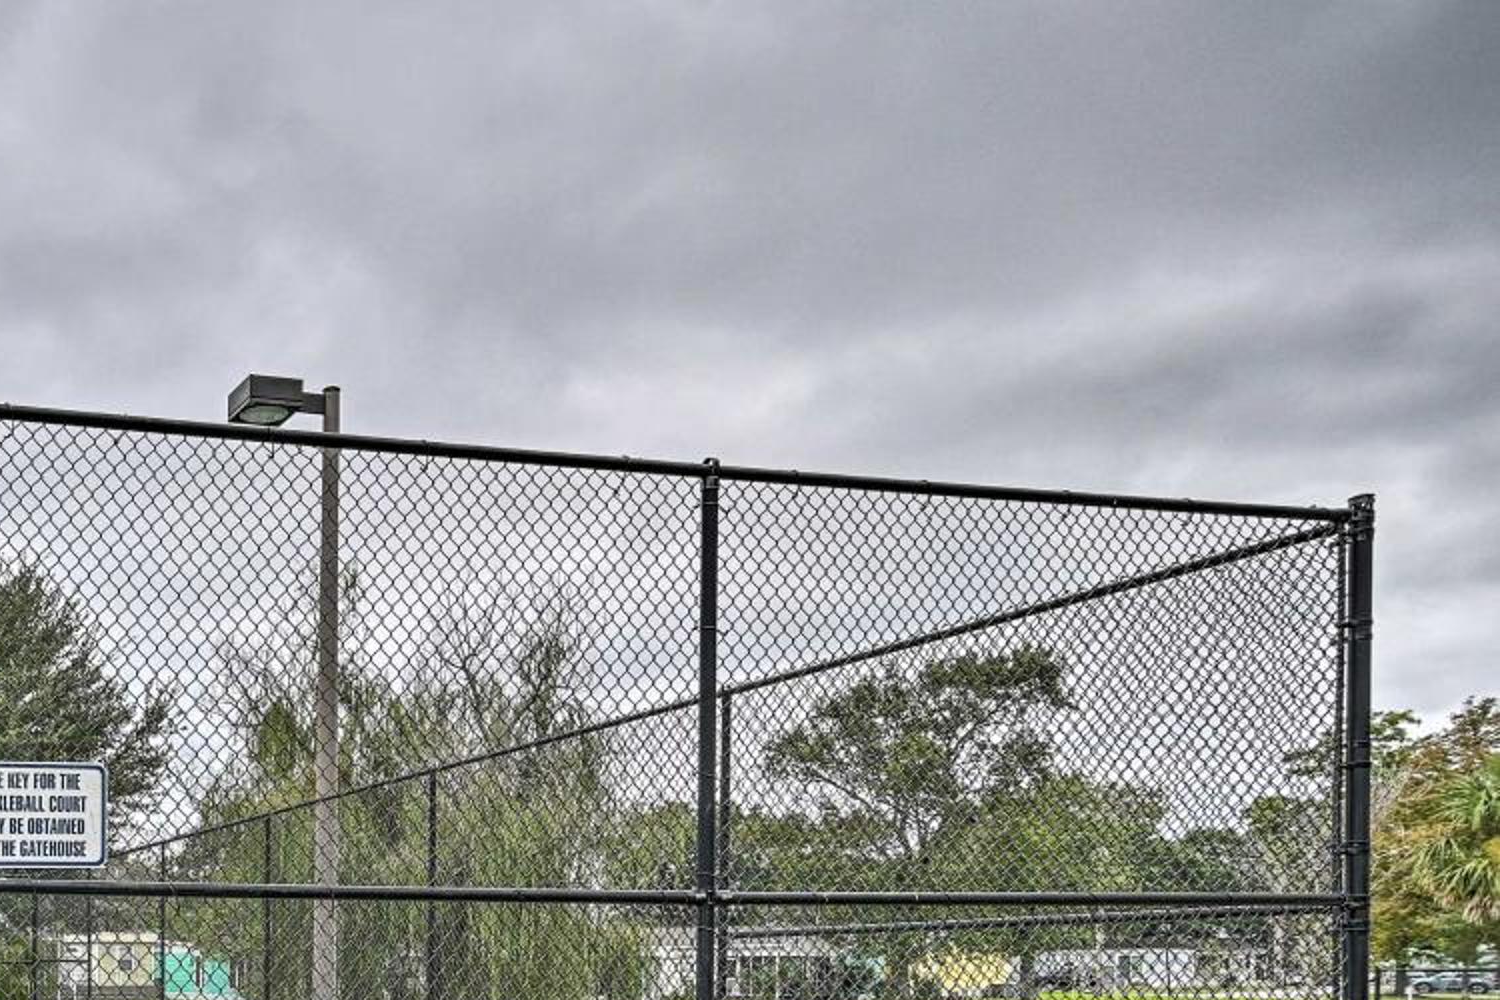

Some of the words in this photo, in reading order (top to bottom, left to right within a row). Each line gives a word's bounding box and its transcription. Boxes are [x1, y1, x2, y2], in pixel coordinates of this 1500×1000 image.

[8, 773, 30, 788] KEY
[34, 774, 56, 789] FOR
[60, 774, 81, 790] THE
[49, 796, 86, 812] COURT
[9, 818, 26, 834] BE
[28, 818, 85, 835] OBTAINED
[20, 840, 87, 856] GATEHOUSE
